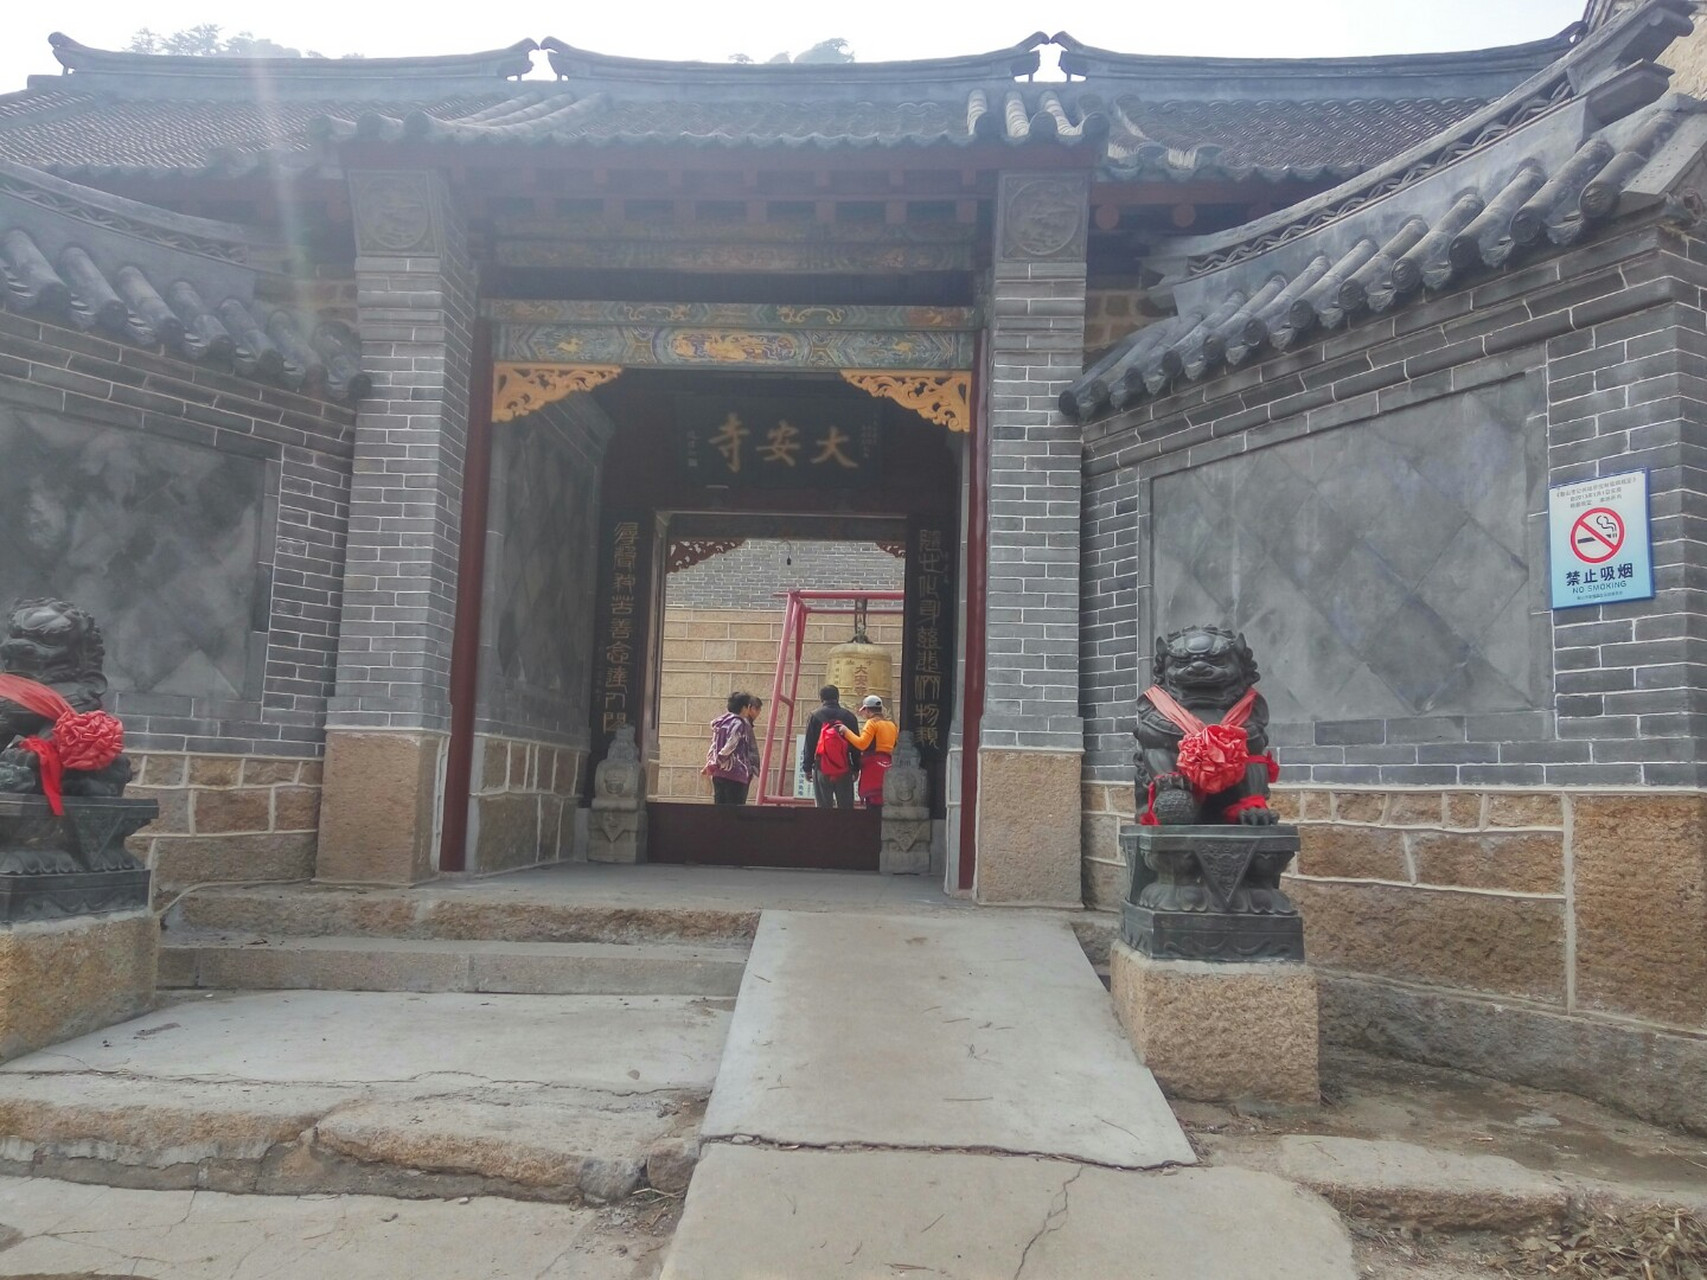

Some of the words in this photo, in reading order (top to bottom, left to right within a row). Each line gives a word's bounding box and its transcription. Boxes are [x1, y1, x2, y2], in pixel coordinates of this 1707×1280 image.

[708, 412, 859, 474] 大安寺
[1566, 563, 1633, 586] 禁止吸烟
[1572, 586, 1585, 594] NO
[1587, 580, 1627, 592] SMOKING
